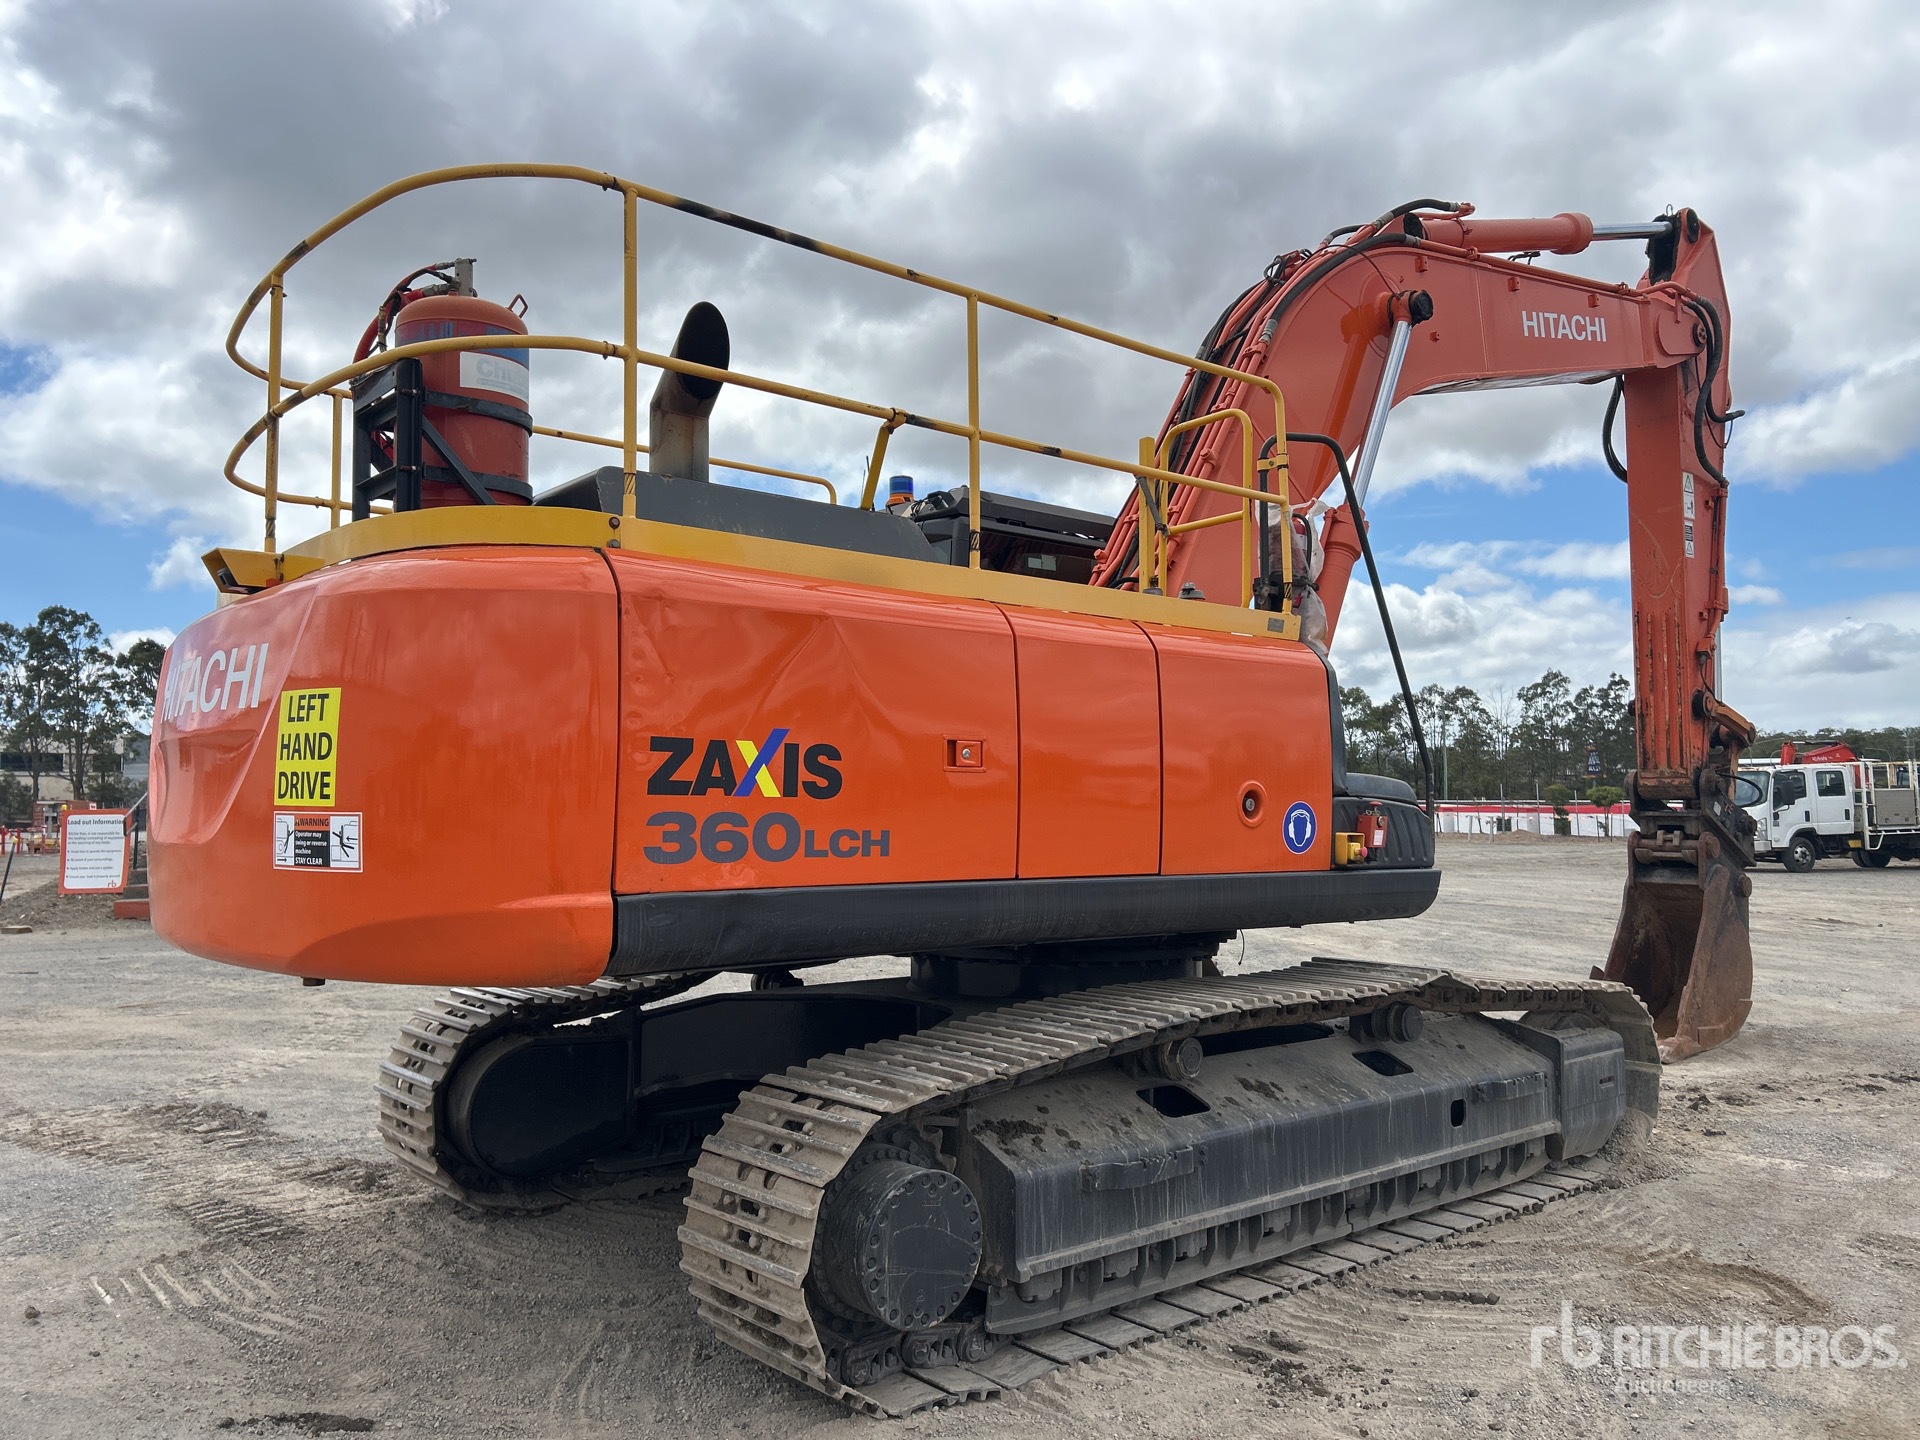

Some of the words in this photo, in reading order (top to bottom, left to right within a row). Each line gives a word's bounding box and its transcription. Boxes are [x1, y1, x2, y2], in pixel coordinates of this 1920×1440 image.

[1522, 310, 1607, 342] HITACHI
[160, 643, 269, 724] HITACHI
[287, 693, 330, 723] LEFT
[279, 731, 333, 761] HAND
[647, 728, 843, 800] ZAXIS
[277, 770, 332, 800] DRIVE
[300, 818, 329, 826] WARNING
